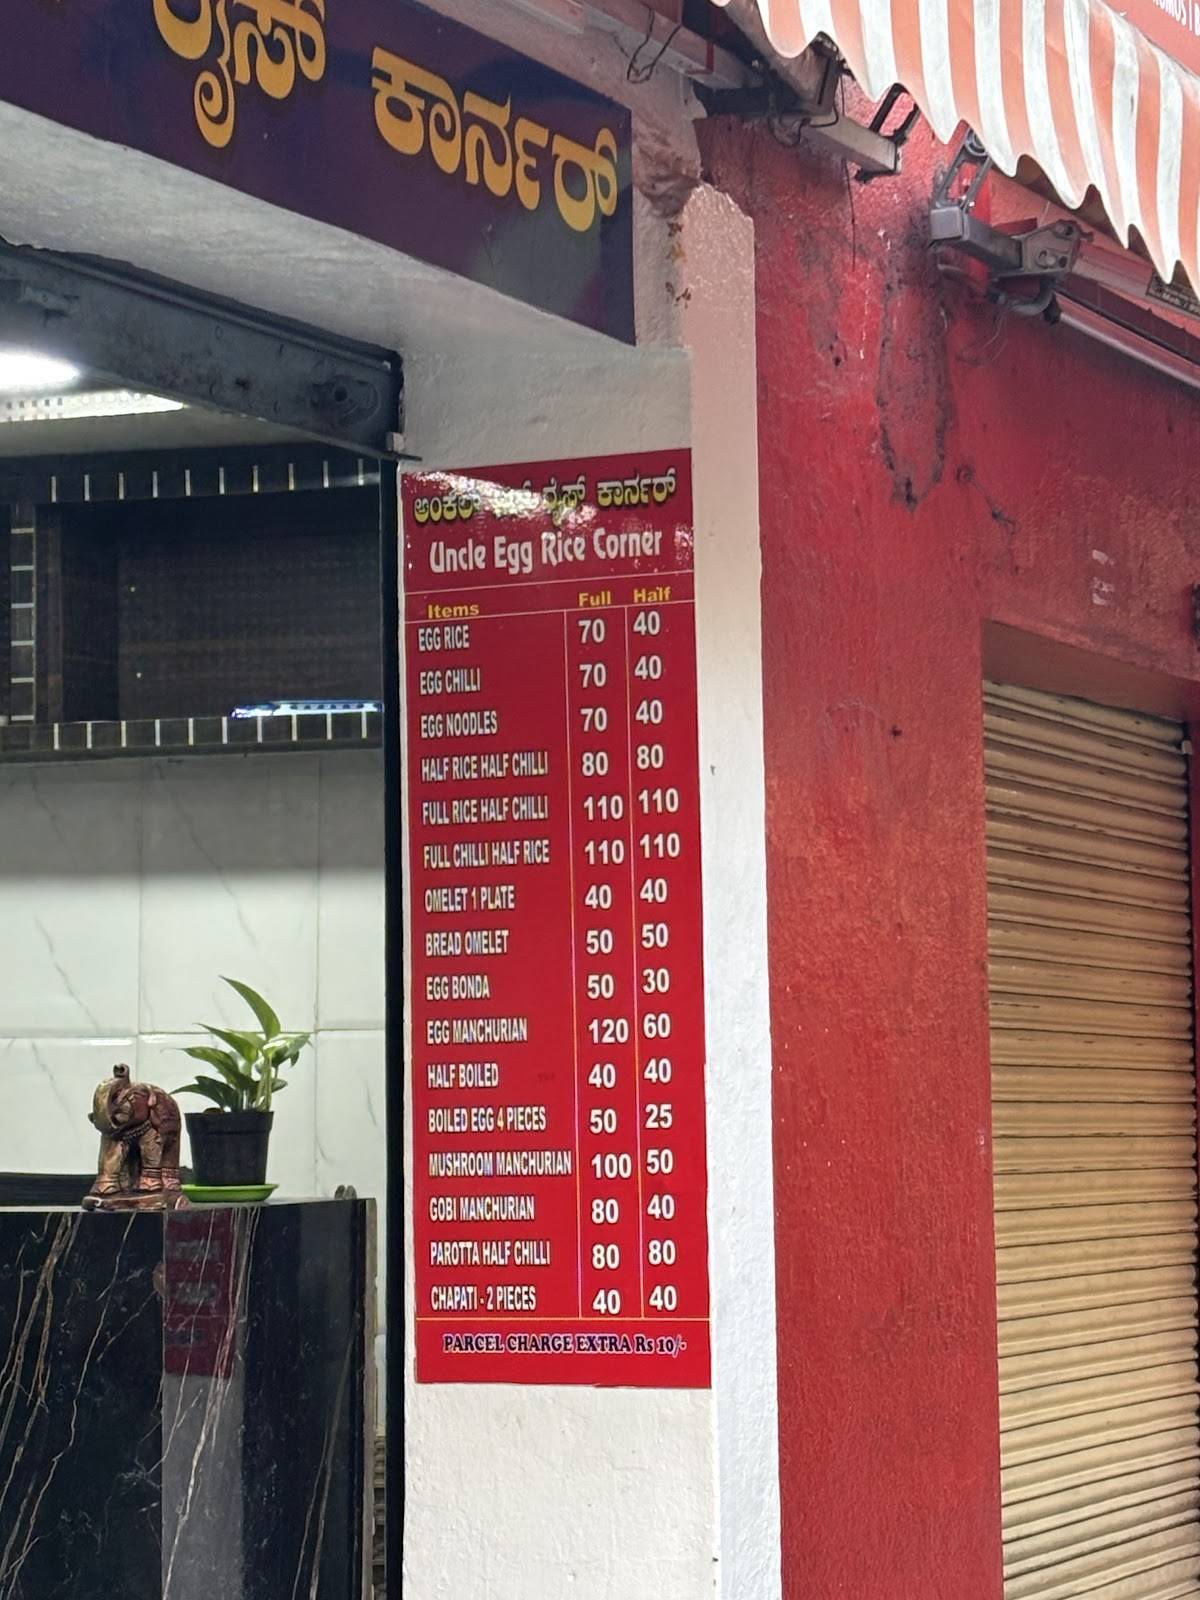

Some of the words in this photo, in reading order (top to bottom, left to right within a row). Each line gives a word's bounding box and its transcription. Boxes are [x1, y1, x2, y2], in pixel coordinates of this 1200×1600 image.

[371, 46, 618, 232] ಕಾರ್ನರ್
[596, 468, 676, 506] ಕಾರ್ನರ್
[430, 538, 486, 574] Uncle
[494, 536, 533, 574] Egg
[540, 531, 586, 566] Rice
[593, 527, 662, 559] Corner
[428, 603, 480, 619] Items
[578, 591, 612, 608] Full
[633, 586, 672, 603] Half
[418, 628, 441, 651] EGG
[444, 625, 470, 649] RICE
[578, 619, 605, 644] 70
[633, 611, 661, 636] 40
[420, 671, 442, 695] EGG
[445, 668, 480, 693] CHILLI
[579, 663, 607, 688] 70
[634, 655, 662, 680] 40
[421, 715, 443, 739] EGG
[446, 711, 498, 737] NOODLES
[580, 707, 608, 732] 70
[635, 700, 663, 725] 40
[422, 758, 449, 782] HALF
[452, 755, 478, 780] RICE
[481, 754, 509, 778] HALF
[512, 751, 548, 776] CHILLI
[582, 752, 608, 776] 80
[636, 745, 664, 769] 80
[422, 801, 449, 826] FULL
[452, 799, 478, 824] RICE
[481, 797, 509, 822] HALF
[512, 796, 548, 820] CHILLI
[583, 796, 623, 821] 110
[638, 788, 679, 814] 110
[423, 845, 450, 869] FULL
[453, 843, 489, 868] CHILLI
[492, 841, 520, 865] HALF
[524, 840, 550, 864] RICE
[584, 840, 625, 865] 110
[639, 833, 680, 858] 110
[425, 888, 468, 912] OMELET
[471, 887, 478, 911] 1
[481, 886, 515, 910] PLATE
[585, 885, 612, 909] 40
[640, 878, 668, 903] 40
[425, 933, 461, 956] BREAD
[464, 930, 509, 955] OMELET
[586, 930, 613, 955] 50
[641, 923, 669, 949] 50
[426, 976, 449, 1001] EGG
[452, 974, 490, 999] BONDA
[587, 974, 614, 999] 50
[643, 968, 670, 994] 30
[427, 1020, 450, 1044] EGG
[453, 1017, 528, 1044] MANCHURIAN
[588, 1019, 629, 1044] 120
[643, 1013, 671, 1039] 60
[427, 1064, 456, 1088] HALF
[459, 1063, 498, 1087] BOILED
[588, 1064, 616, 1089] 40
[644, 1058, 672, 1084] 40
[428, 1109, 468, 1133] BOILED
[471, 1108, 494, 1132] EGG
[497, 1108, 504, 1131] 4
[507, 1107, 546, 1131] PIECES
[589, 1109, 617, 1134] 50
[645, 1104, 673, 1129] 25
[429, 1152, 493, 1177] MUSHROOM
[496, 1150, 572, 1176] MANCHURIAN
[591, 1154, 632, 1179] 100
[646, 1149, 674, 1174] 50
[430, 1197, 457, 1221] GOBI
[459, 1196, 535, 1220] MANCHURIAN
[591, 1199, 619, 1224] 80
[647, 1195, 675, 1220] 40
[430, 1241, 480, 1265] PAROTTA
[483, 1241, 510, 1265] HALF
[514, 1241, 550, 1265] CHILLI
[592, 1245, 620, 1269] 80
[649, 1240, 676, 1265] 80
[431, 1286, 477, 1310] CHAPATI
[487, 1286, 493, 1310] 2
[496, 1286, 536, 1310] PIECES
[593, 1290, 621, 1315] 40
[649, 1286, 677, 1311] 40
[443, 1334, 504, 1354] PARCEL
[507, 1334, 572, 1354] CHARGE
[575, 1335, 631, 1355] EXTRA
[635, 1335, 654, 1355] Rs
